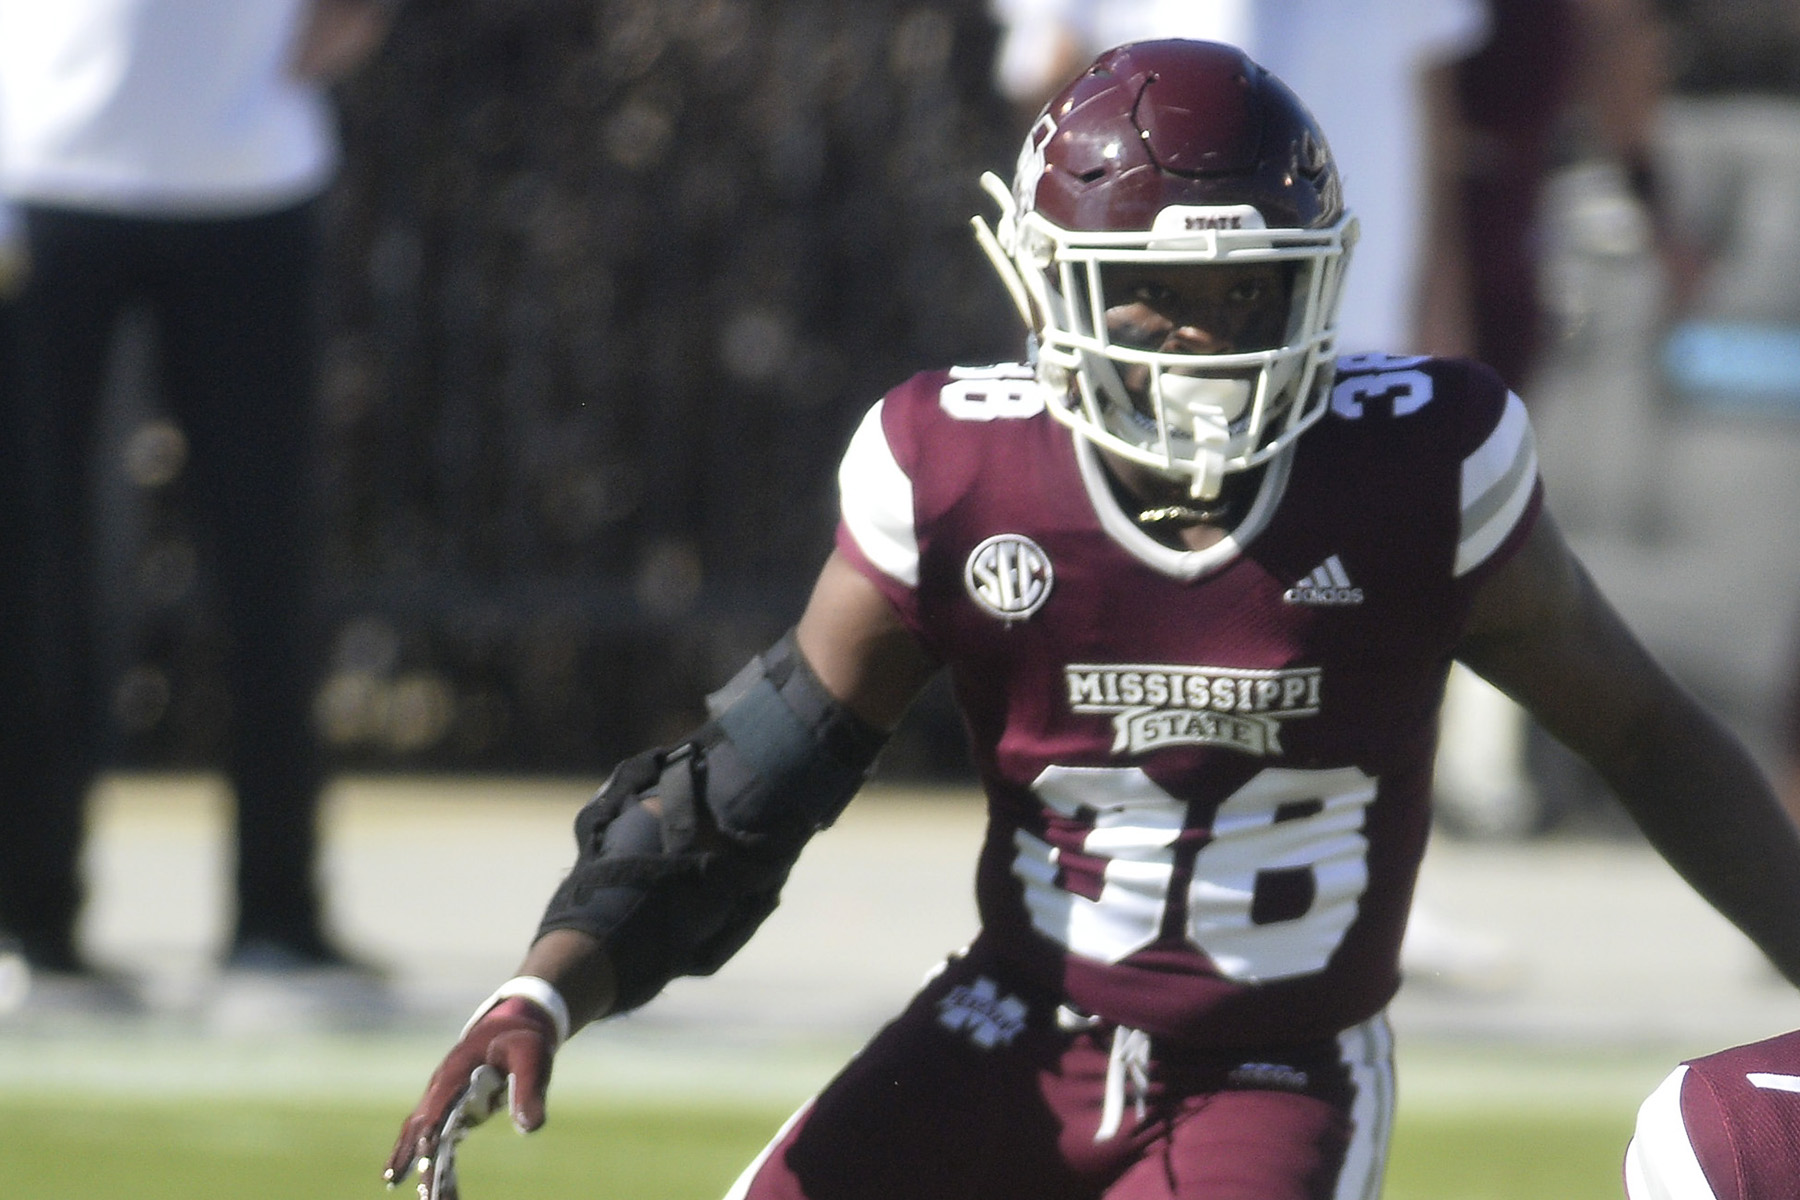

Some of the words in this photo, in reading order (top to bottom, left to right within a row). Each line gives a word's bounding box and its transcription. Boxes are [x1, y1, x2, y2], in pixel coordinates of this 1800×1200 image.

[972, 539, 1046, 611] SEC
[1067, 672, 1321, 712] MISSISSIPPI
[1142, 711, 1253, 742] STATE
[1011, 763, 1380, 985] 38
